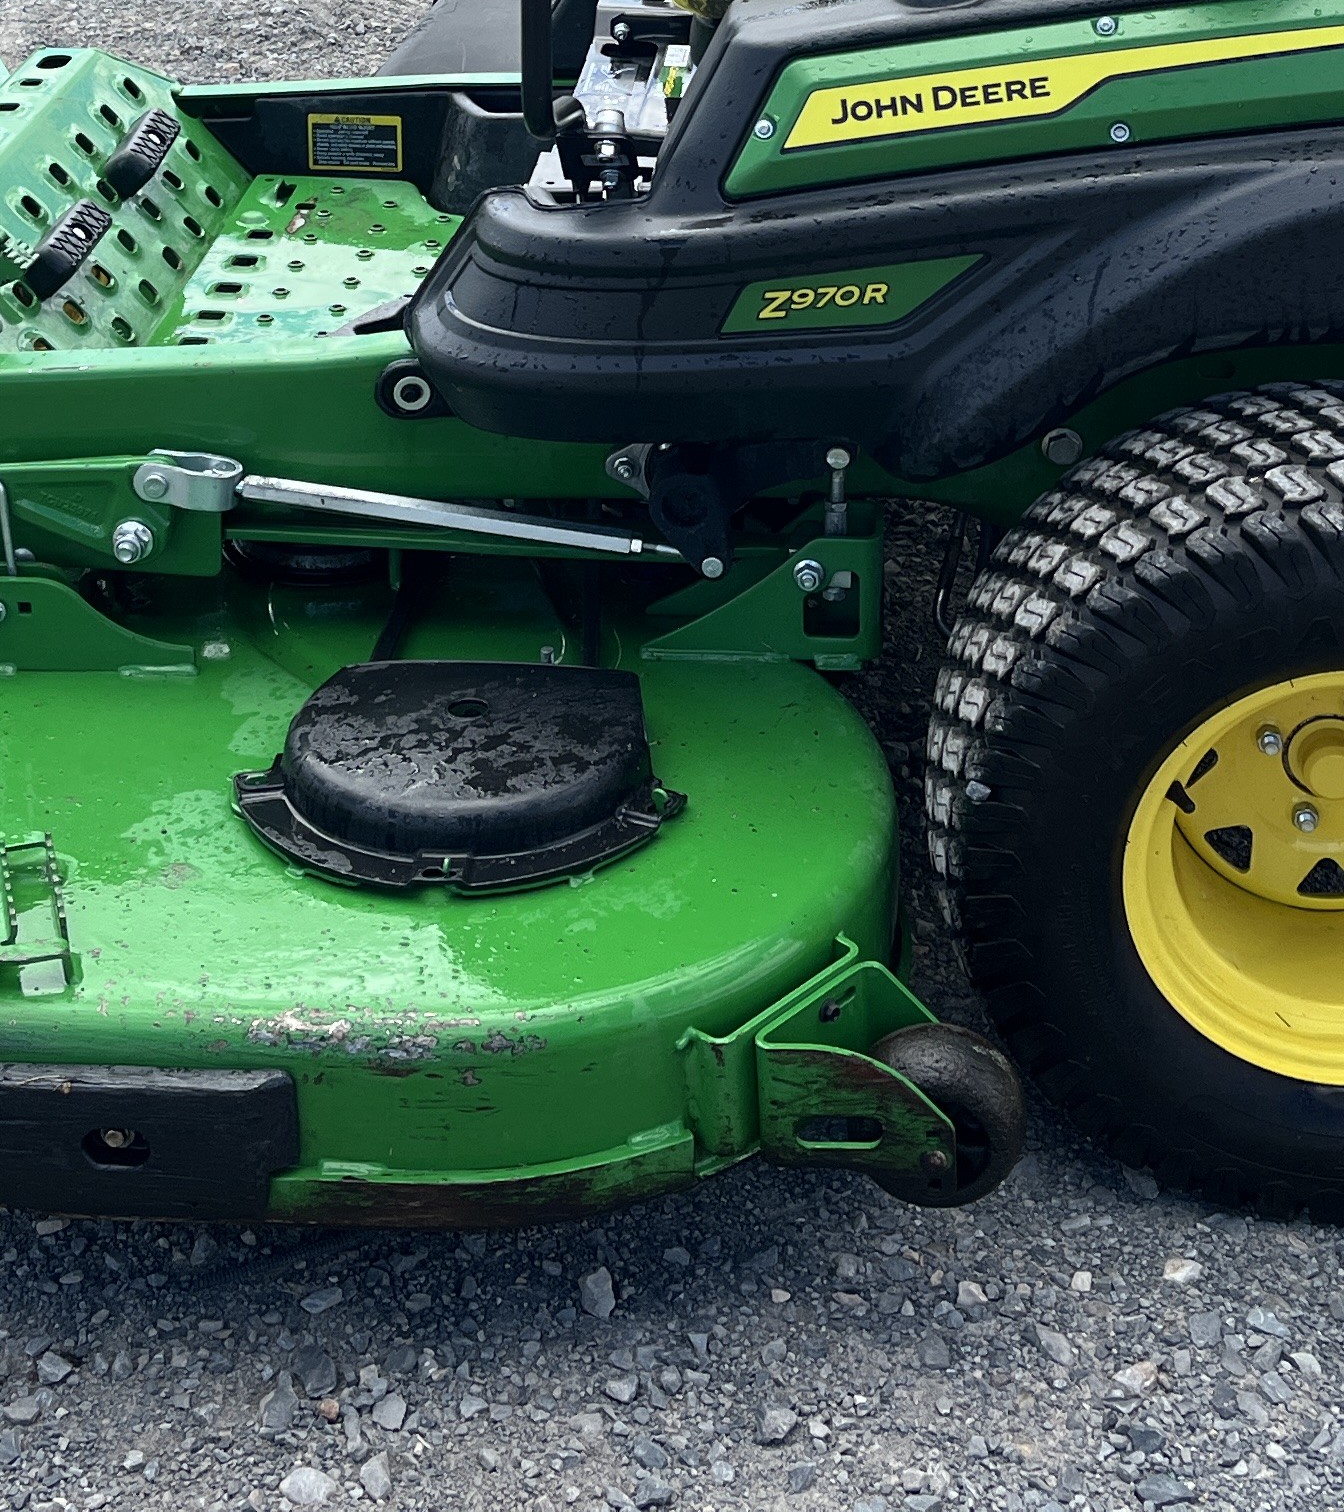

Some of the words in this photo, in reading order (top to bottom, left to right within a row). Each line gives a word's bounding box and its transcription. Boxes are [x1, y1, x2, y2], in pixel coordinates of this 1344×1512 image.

[831, 93, 924, 125] JOHN
[932, 76, 1051, 112] DEERE
[758, 283, 889, 319] Z970R
